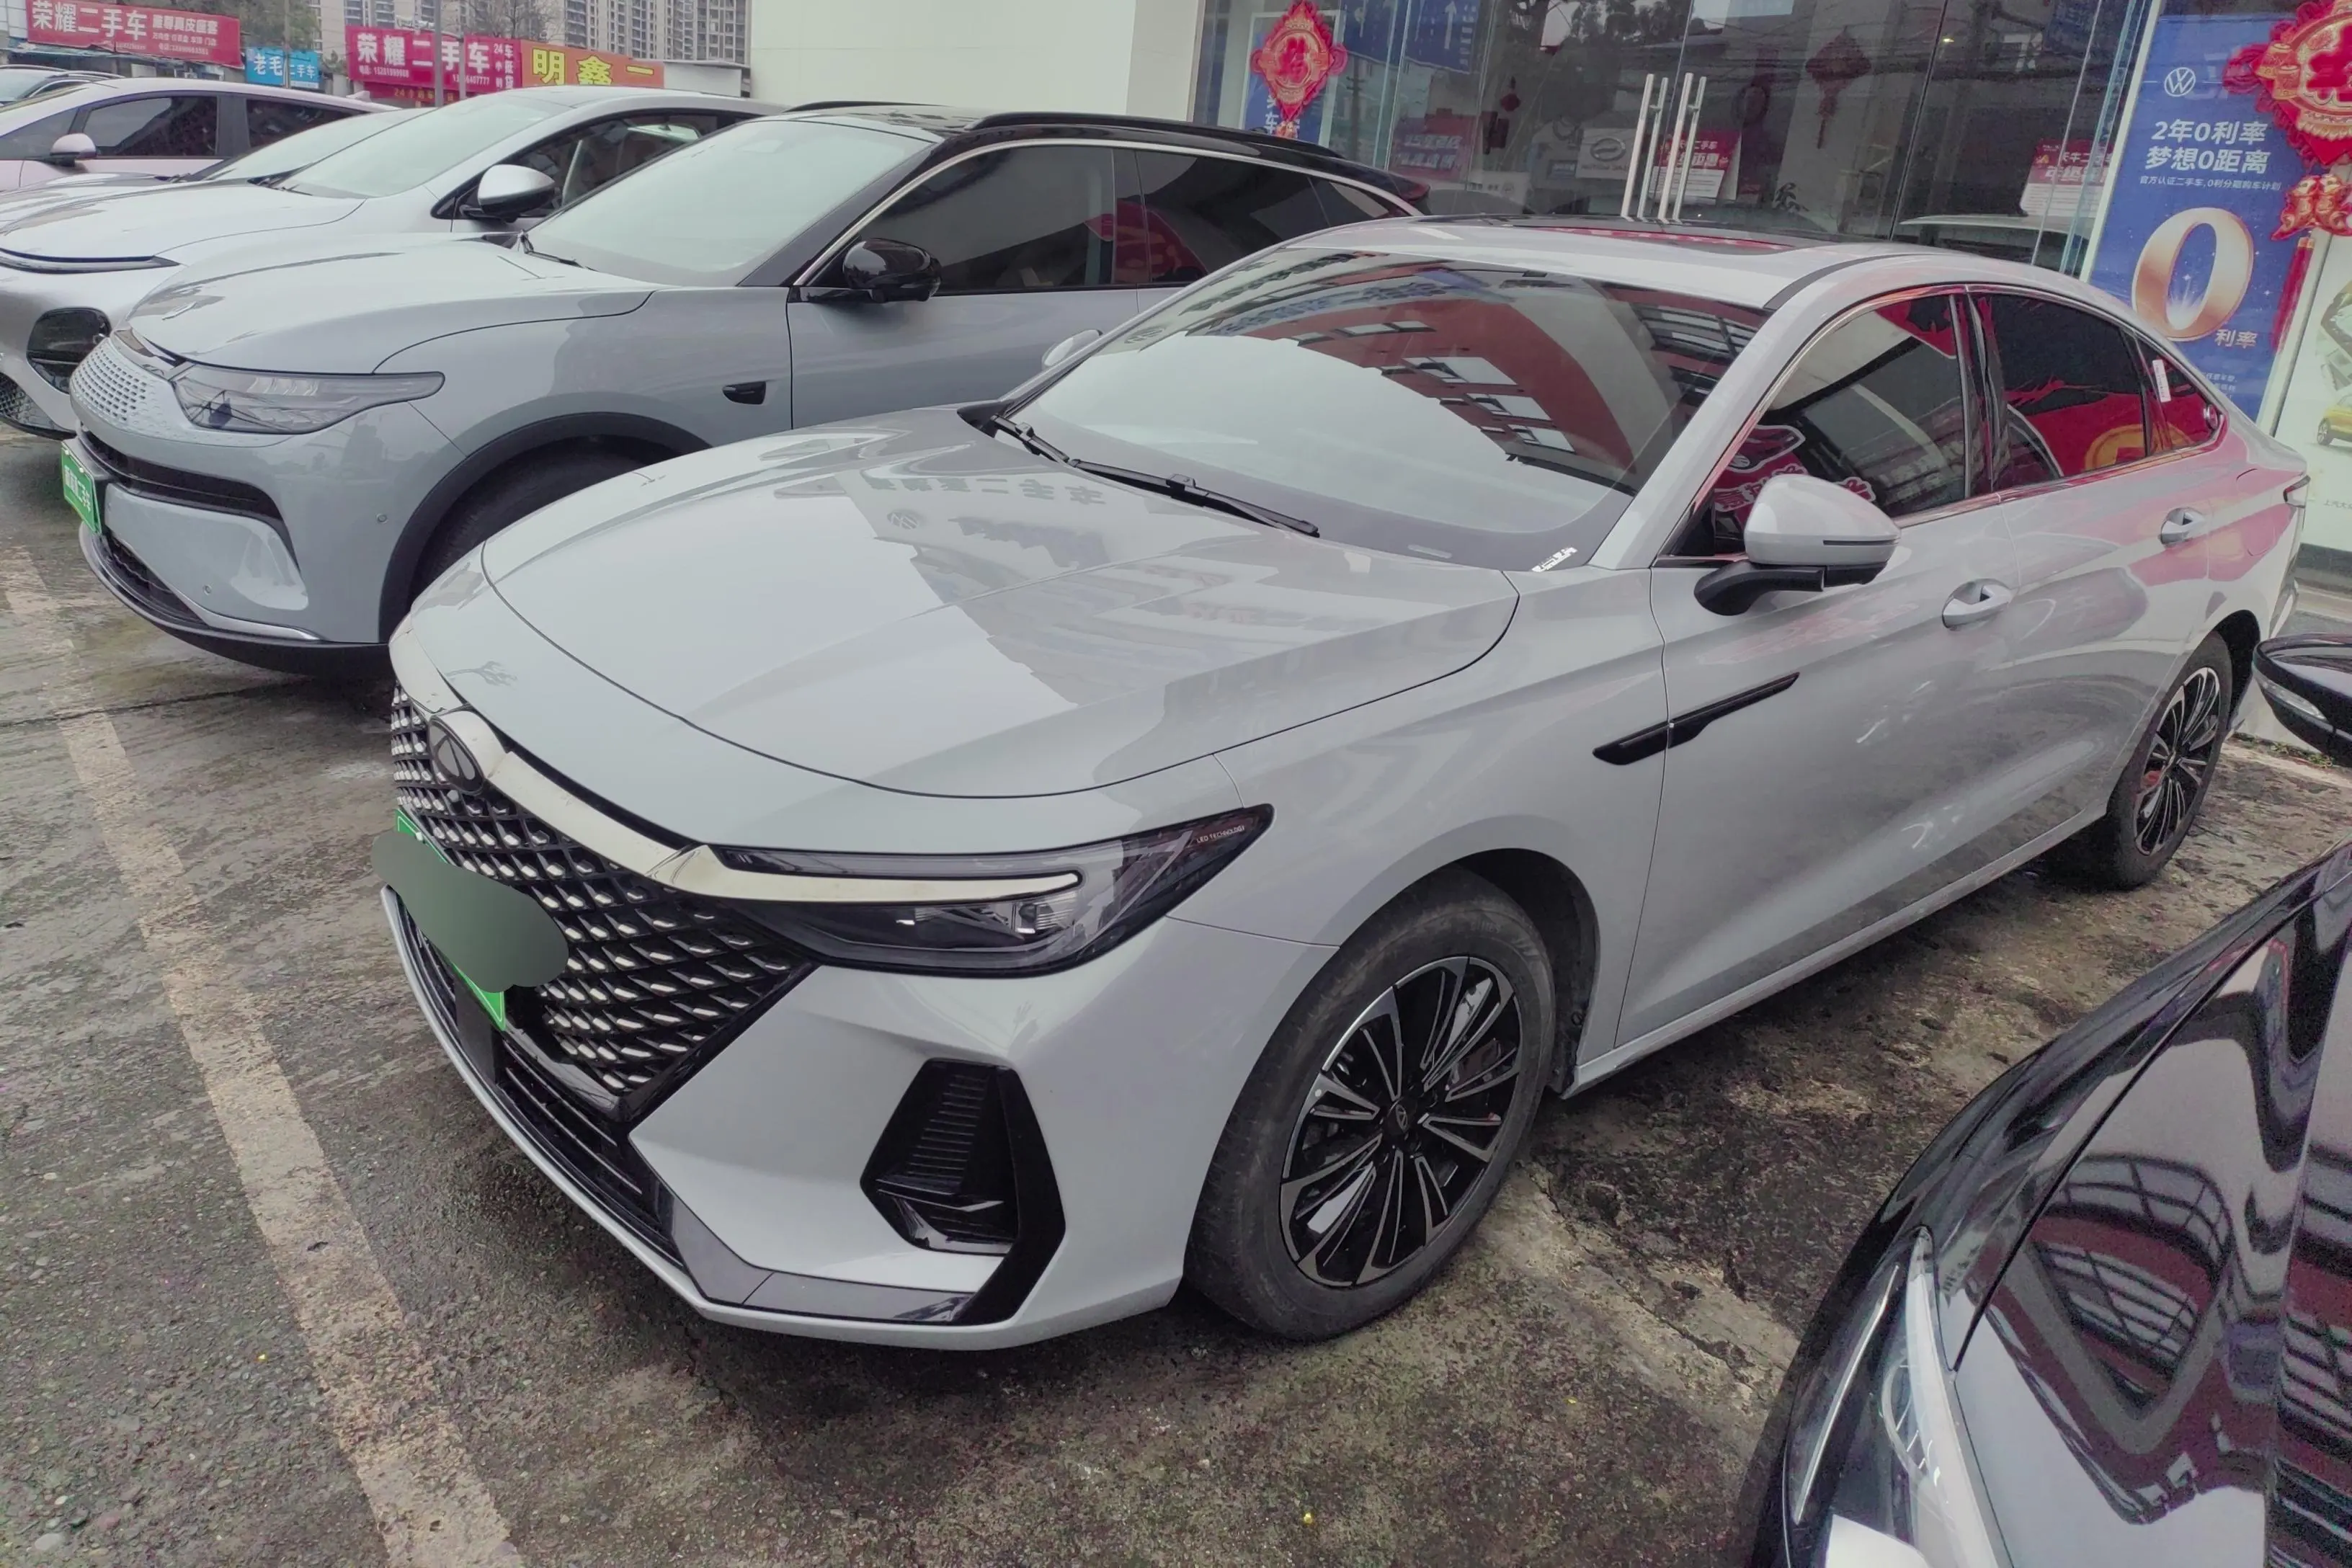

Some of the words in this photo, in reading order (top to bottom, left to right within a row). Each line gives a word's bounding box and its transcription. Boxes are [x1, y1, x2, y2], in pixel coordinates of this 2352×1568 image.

[32, 2, 147, 40] 荣耀二手车
[357, 34, 490, 74] 荣耀二手车
[2151, 118, 2268, 145] 2年0利率
[2144, 146, 2271, 174] 梦想0距离
[2214, 329, 2258, 349] 利率
[1196, 835, 1209, 844] LED
